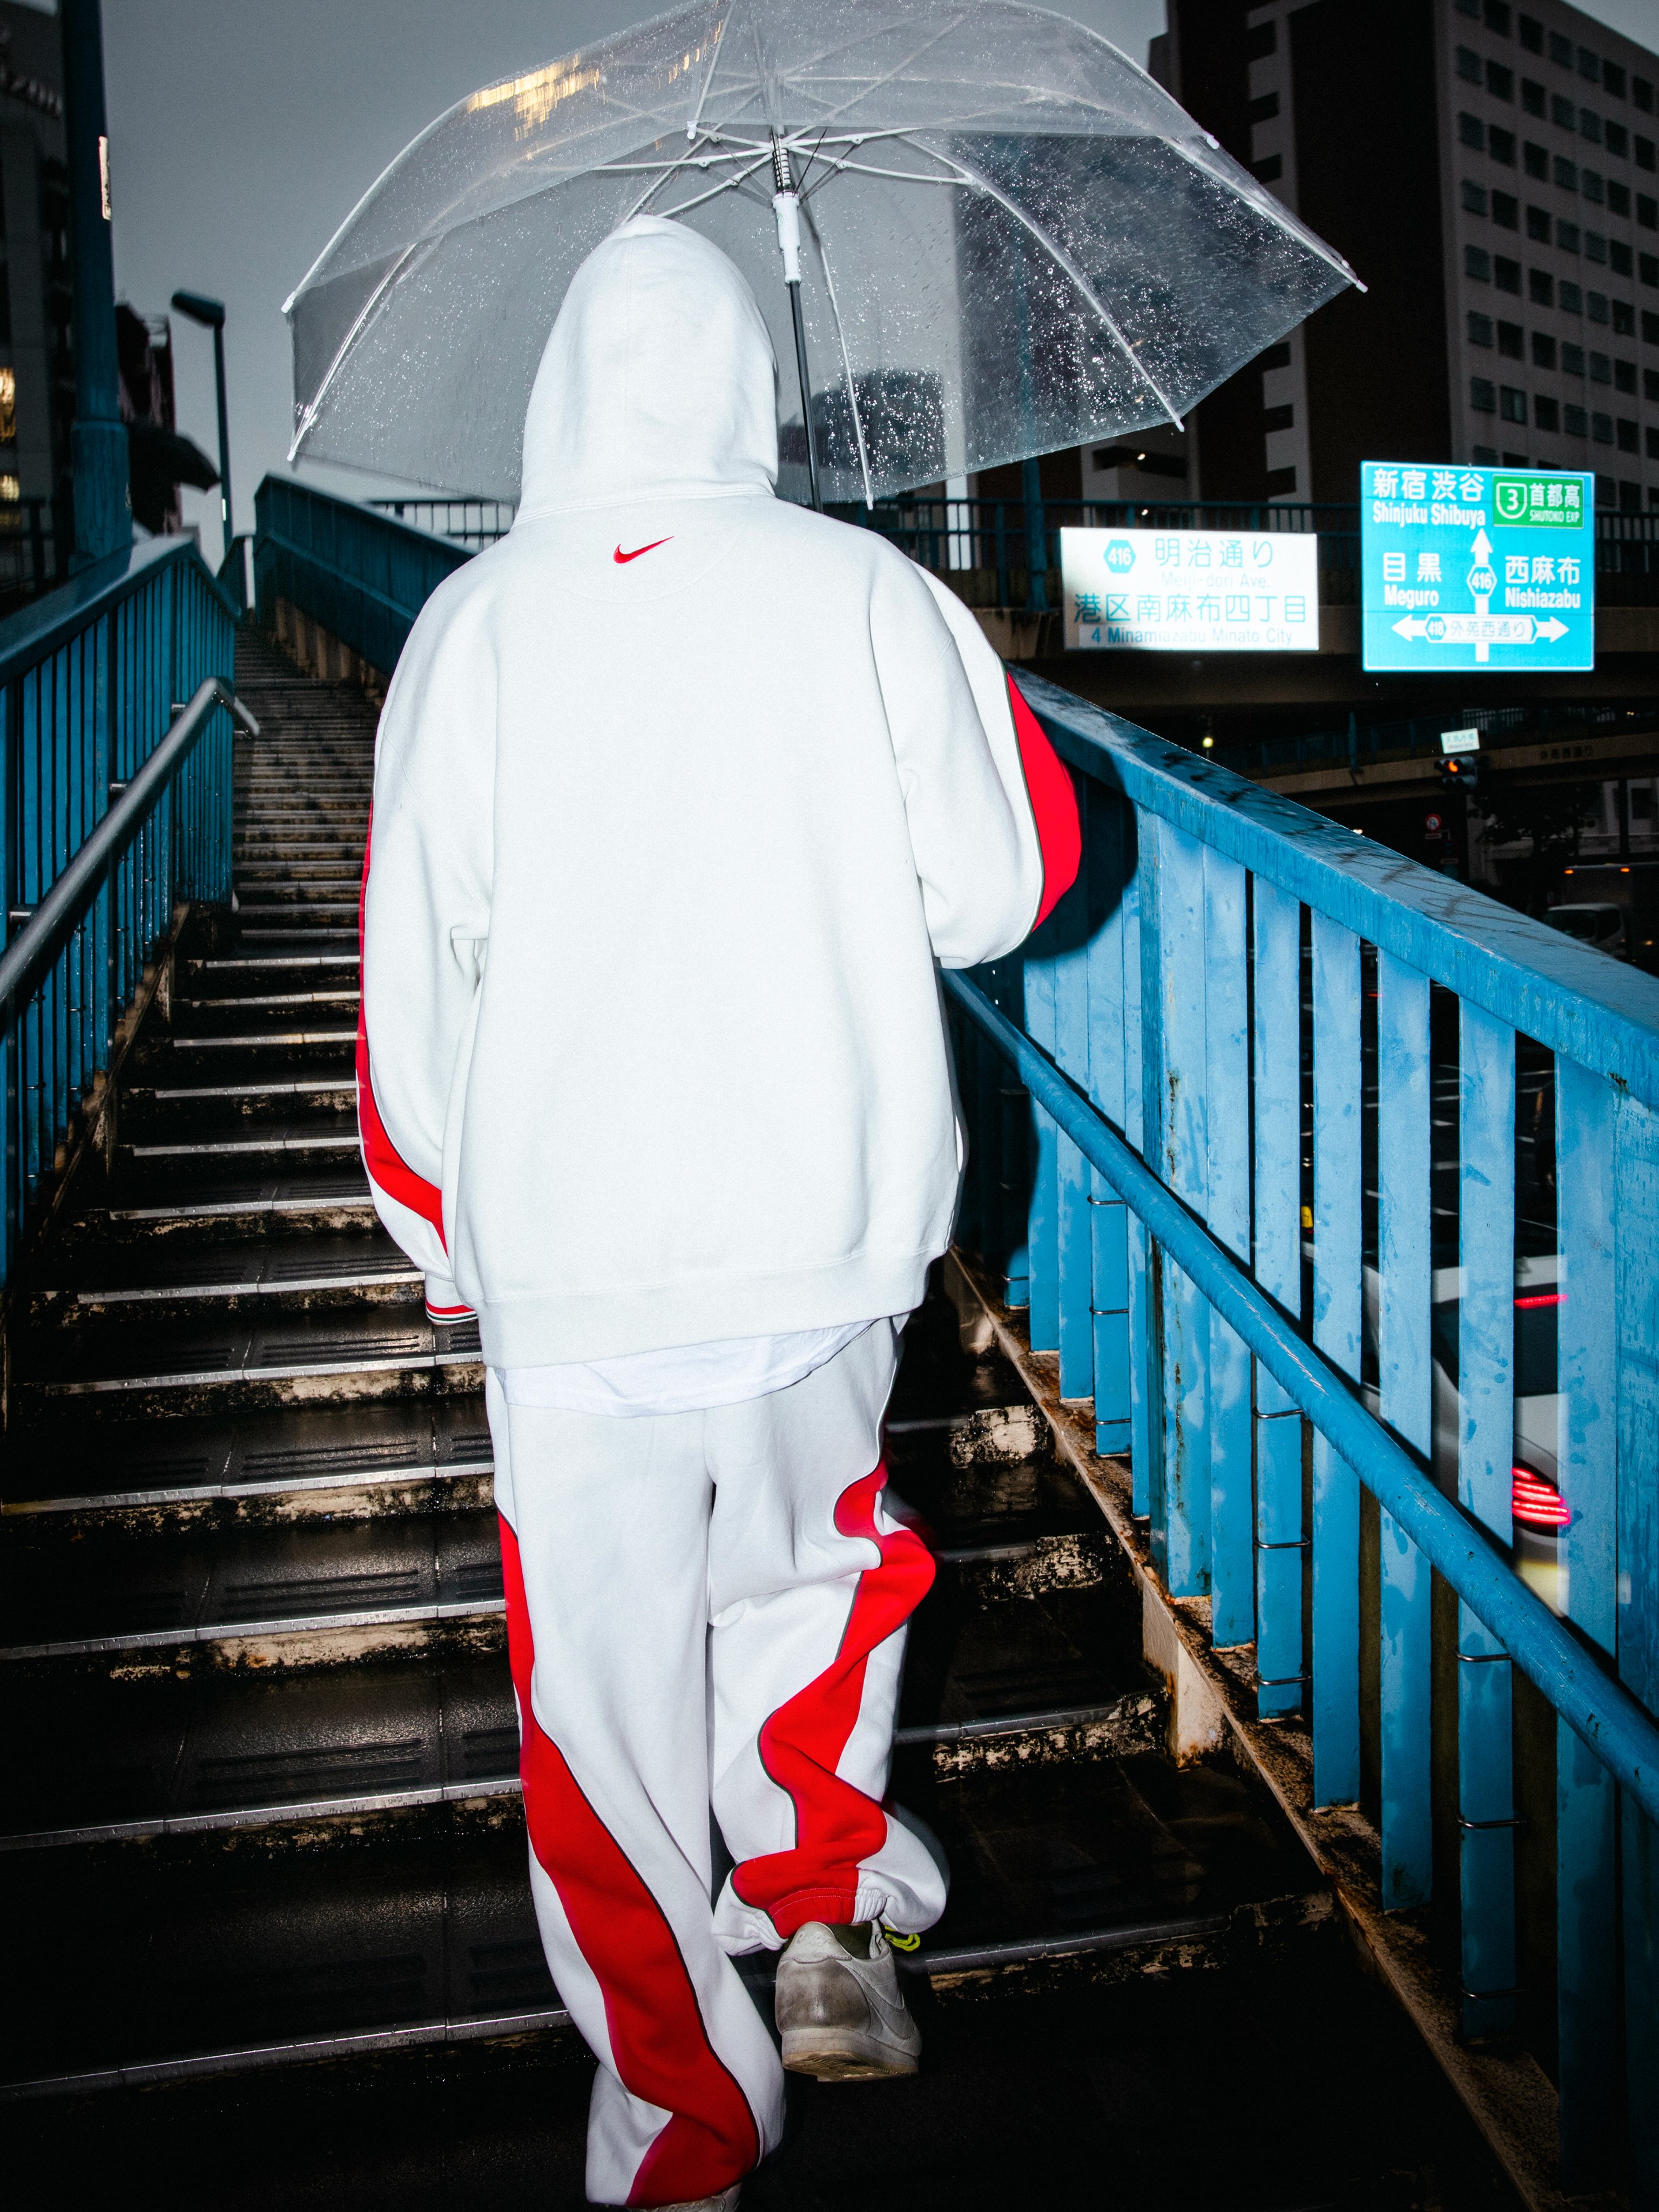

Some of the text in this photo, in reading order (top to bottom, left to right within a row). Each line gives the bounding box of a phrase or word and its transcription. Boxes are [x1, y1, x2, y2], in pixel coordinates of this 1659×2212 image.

[1507, 488, 1519, 511] 3
[1529, 482, 1580, 508] 首都高
[1373, 501, 1486, 530] Shinjuku Shibuya
[1529, 509, 1564, 522] SHUTOKO
[1108, 547, 1131, 566] 416
[1155, 537, 1273, 568] 明治通り
[1383, 552, 1442, 582] 目黒
[1505, 555, 1581, 585] 西麻布
[1162, 572, 1270, 591] Meiji-dori Ave.
[1471, 572, 1493, 589] 416
[1074, 593, 1306, 623] 港区南麻布四丁目
[1384, 585, 1439, 609] Meguro
[1505, 587, 1581, 609] Nishiazabu
[1091, 626, 1293, 646] 4 Minamiazabu Minato City
[1451, 621, 1526, 638] 外苑西通り
